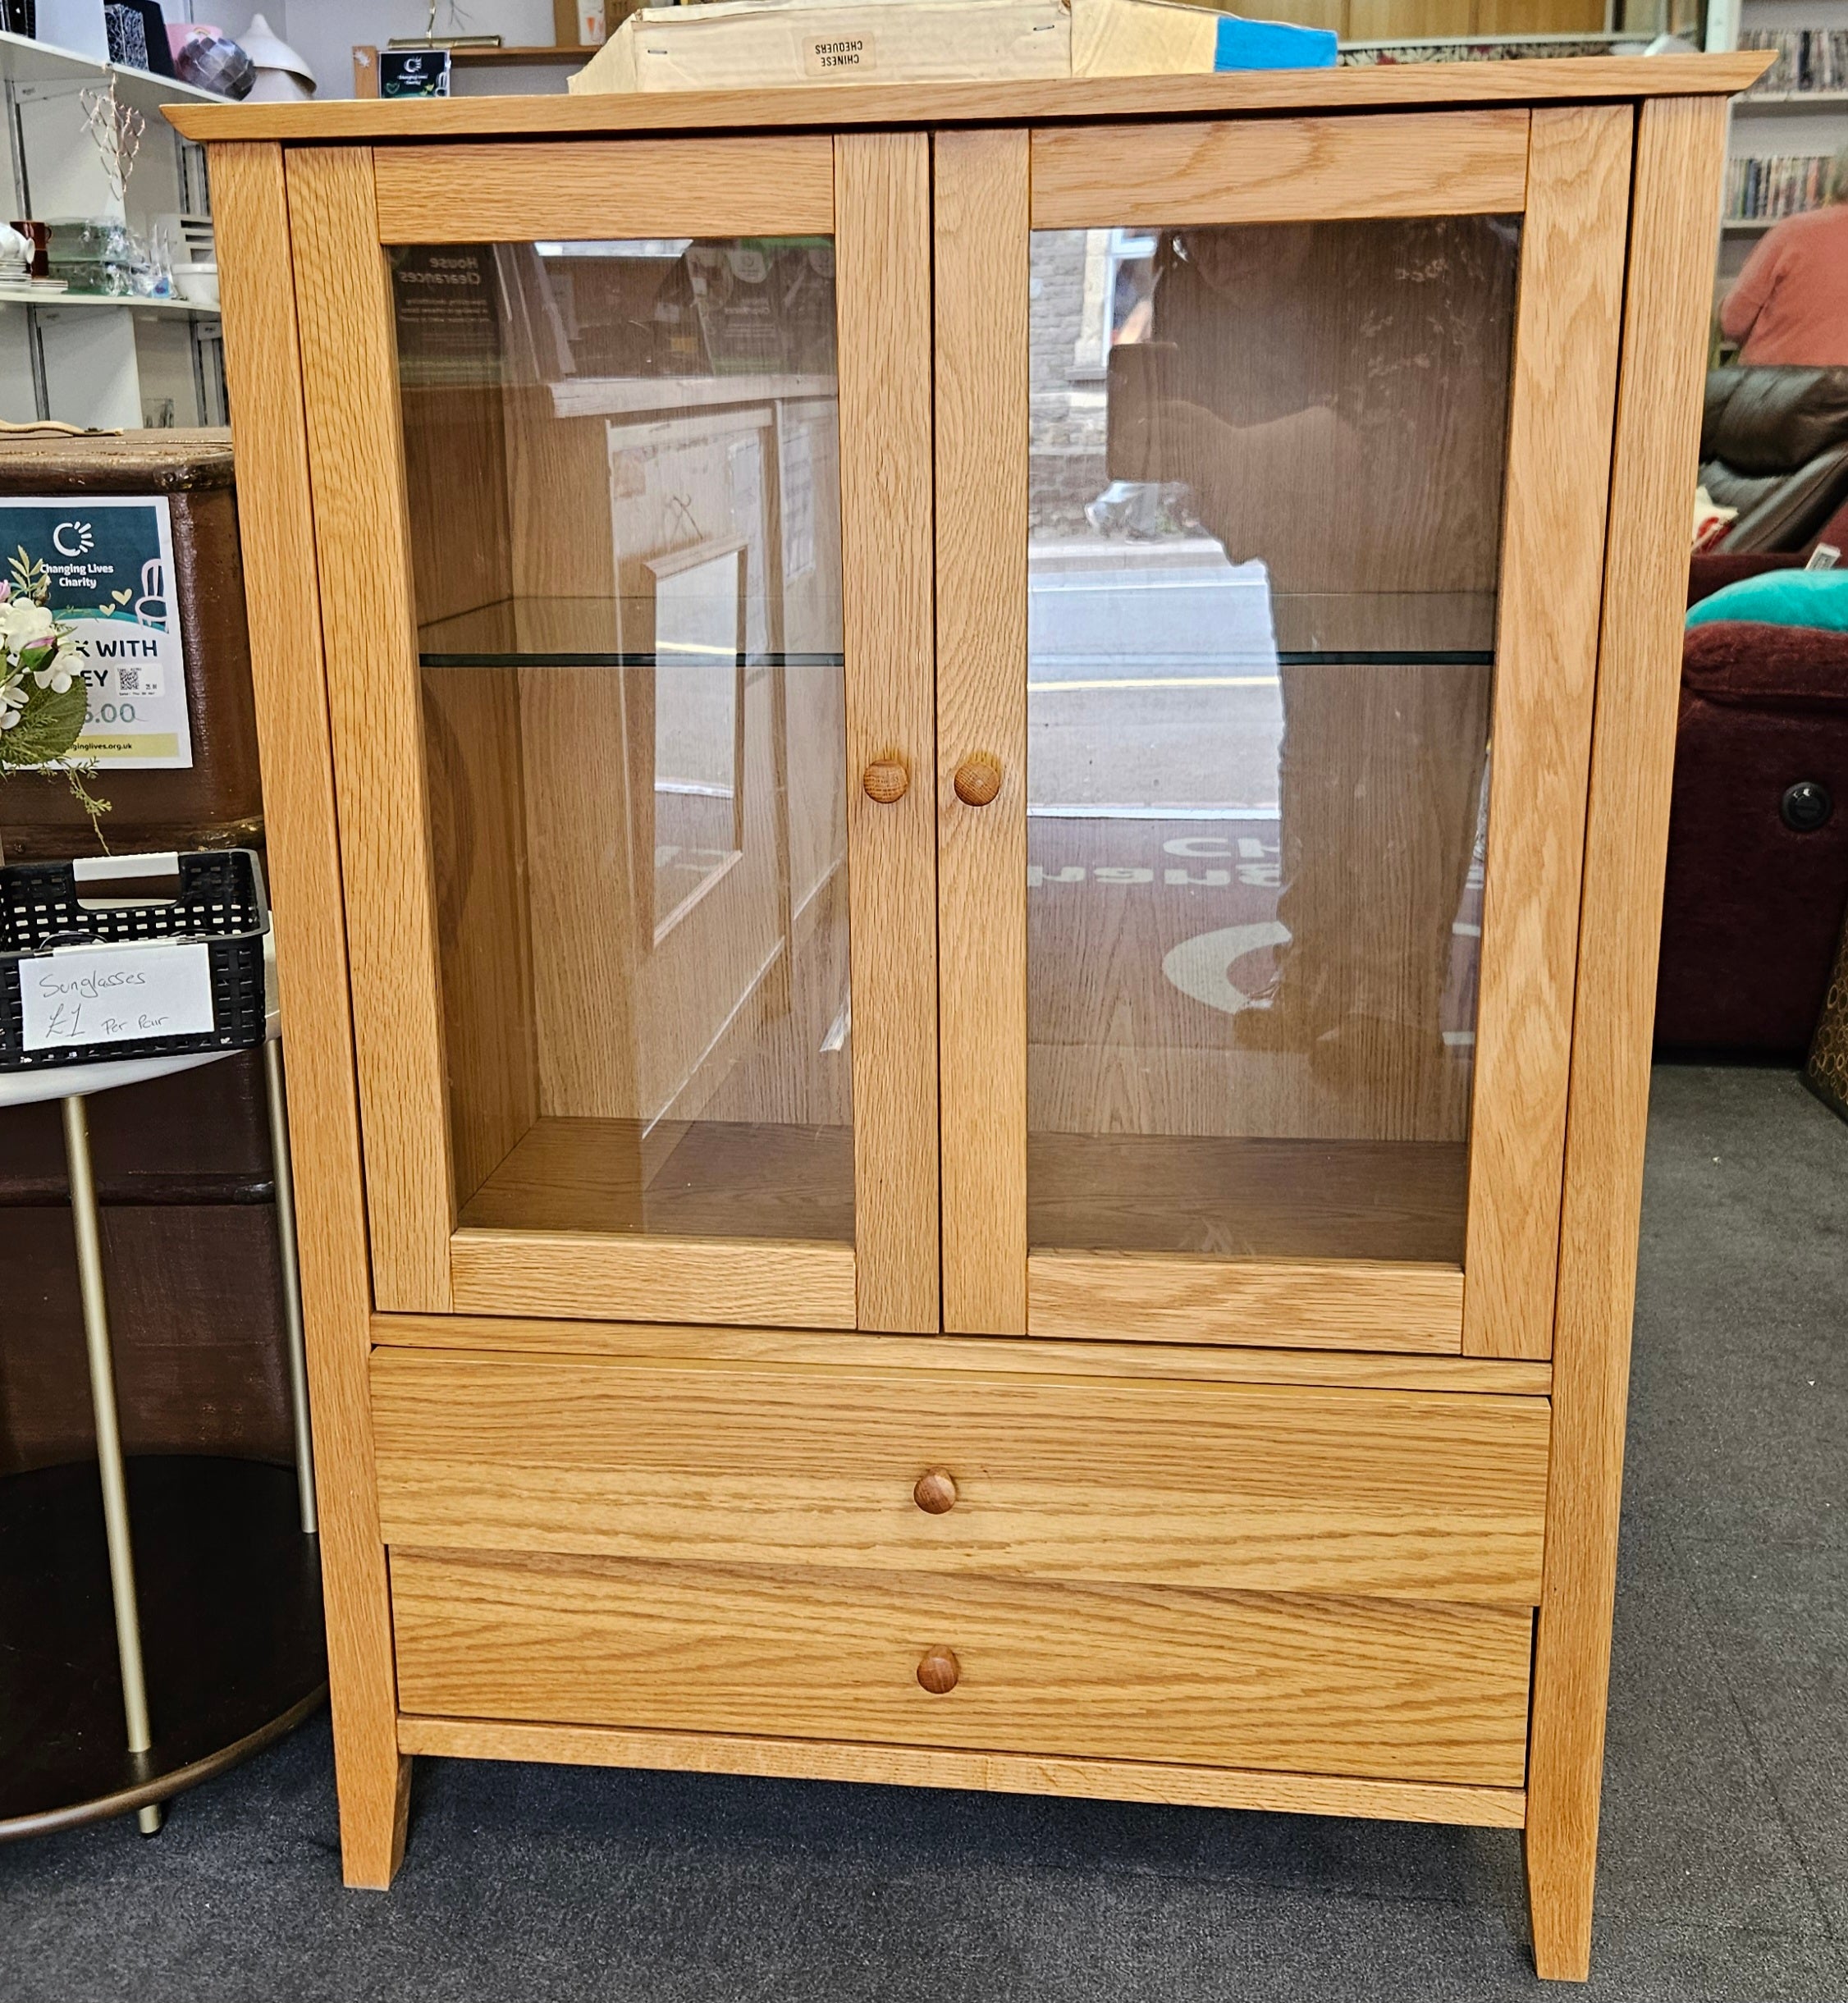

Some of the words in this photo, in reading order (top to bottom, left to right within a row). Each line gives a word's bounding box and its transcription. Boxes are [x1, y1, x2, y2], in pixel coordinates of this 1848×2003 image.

[815, 40, 863, 55] CHEQUERS
[821, 54, 859, 67] CHINESE
[39, 563, 86, 576] Changing
[87, 563, 114, 574] Lives
[58, 577, 97, 589] Charity
[96, 640, 158, 658] WITH
[80, 670, 108, 687] EY
[71, 742, 132, 751] ginglives.org.uk
[39, 969, 147, 998] Sunglasses
[45, 1004, 85, 1039] £1
